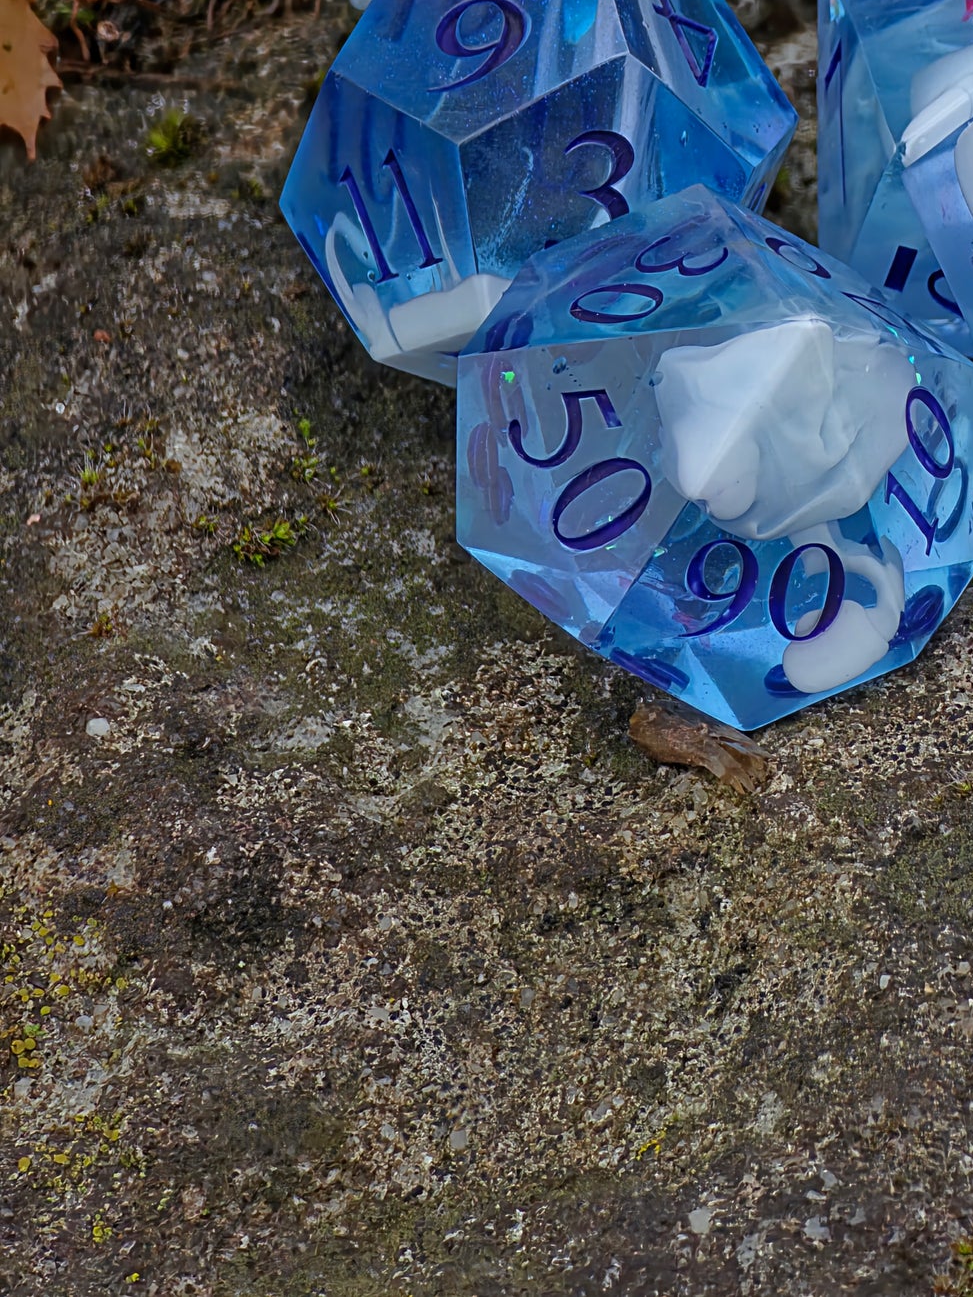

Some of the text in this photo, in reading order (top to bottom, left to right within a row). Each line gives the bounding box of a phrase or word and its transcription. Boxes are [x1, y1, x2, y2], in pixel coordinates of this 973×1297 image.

[338, 149, 443, 283] 11
[545, 129, 635, 249] 3
[570, 236, 729, 324] 30
[508, 389, 652, 552] 50
[884, 386, 954, 557] 10
[678, 539, 845, 641] 90
